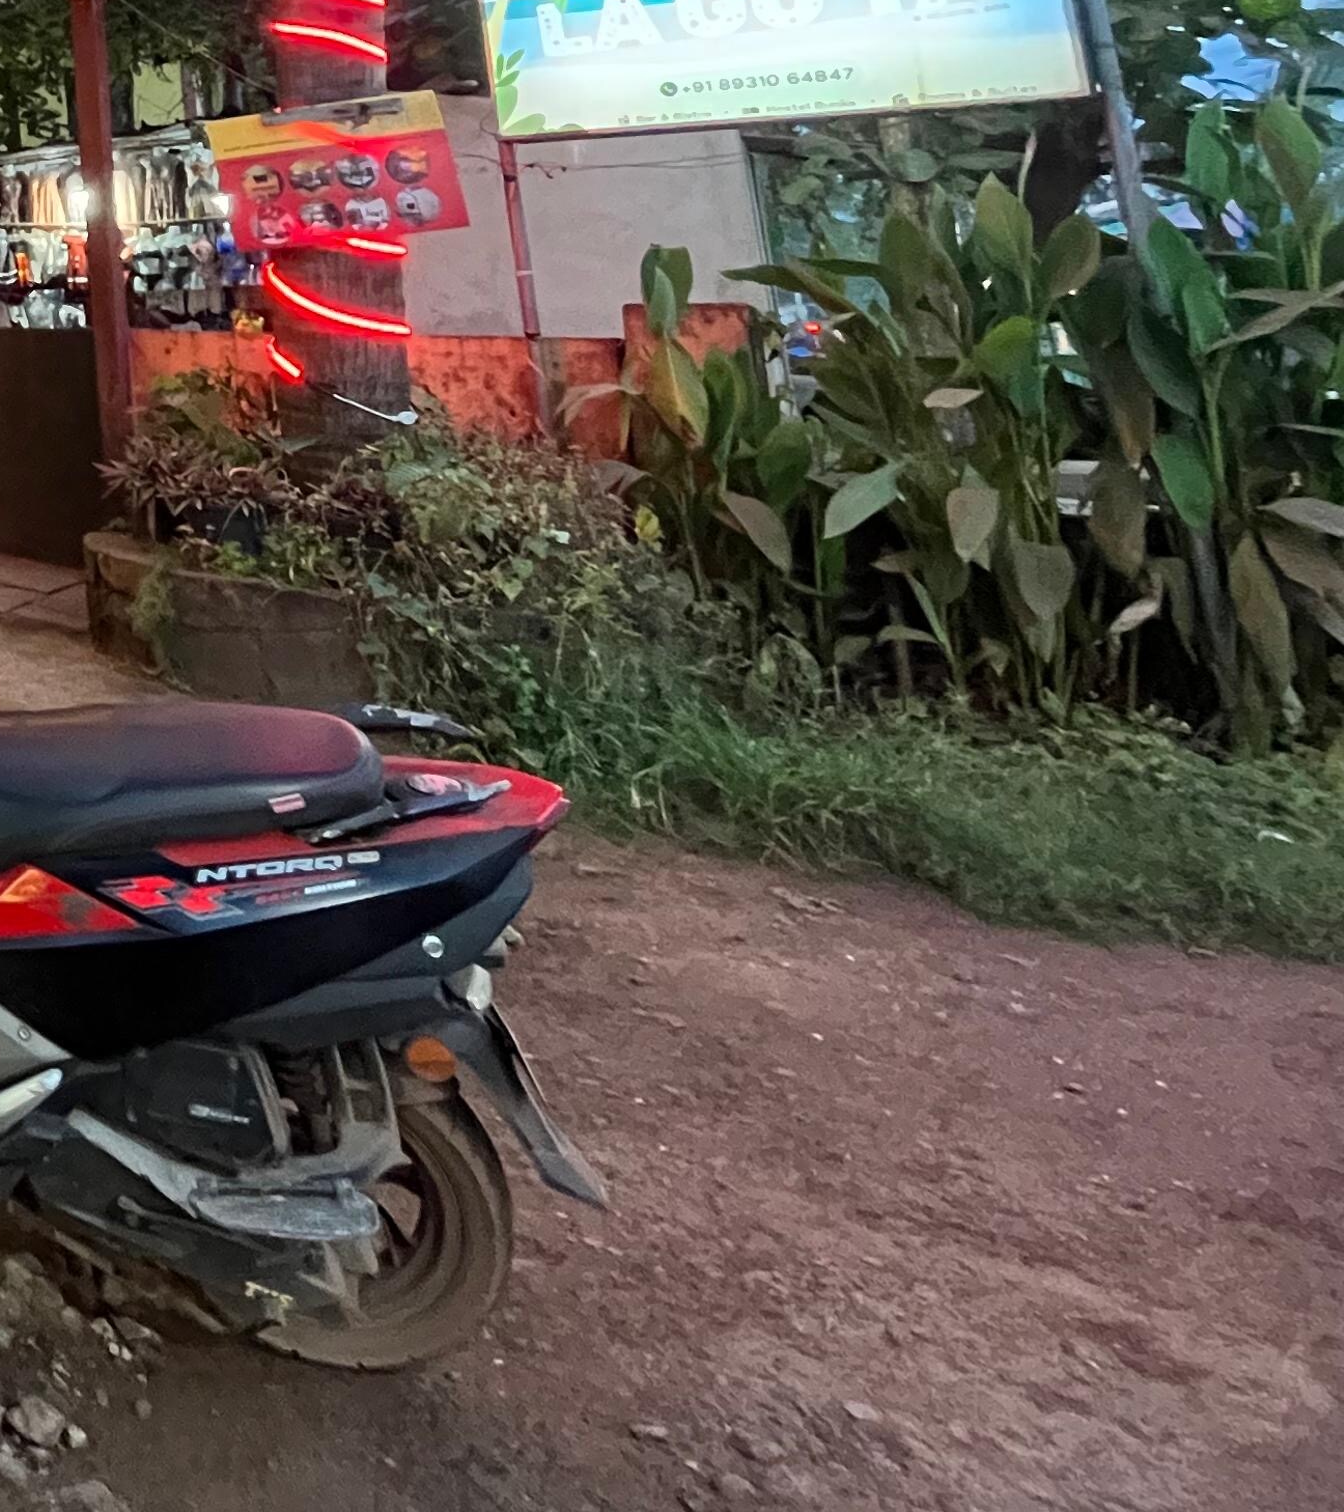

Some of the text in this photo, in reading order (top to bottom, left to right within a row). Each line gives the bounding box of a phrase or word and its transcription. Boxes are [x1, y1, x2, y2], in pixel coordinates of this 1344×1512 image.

[719, 74, 780, 91] 89310
[786, 67, 854, 85] 64847
[196, 854, 343, 884] NTORQ
